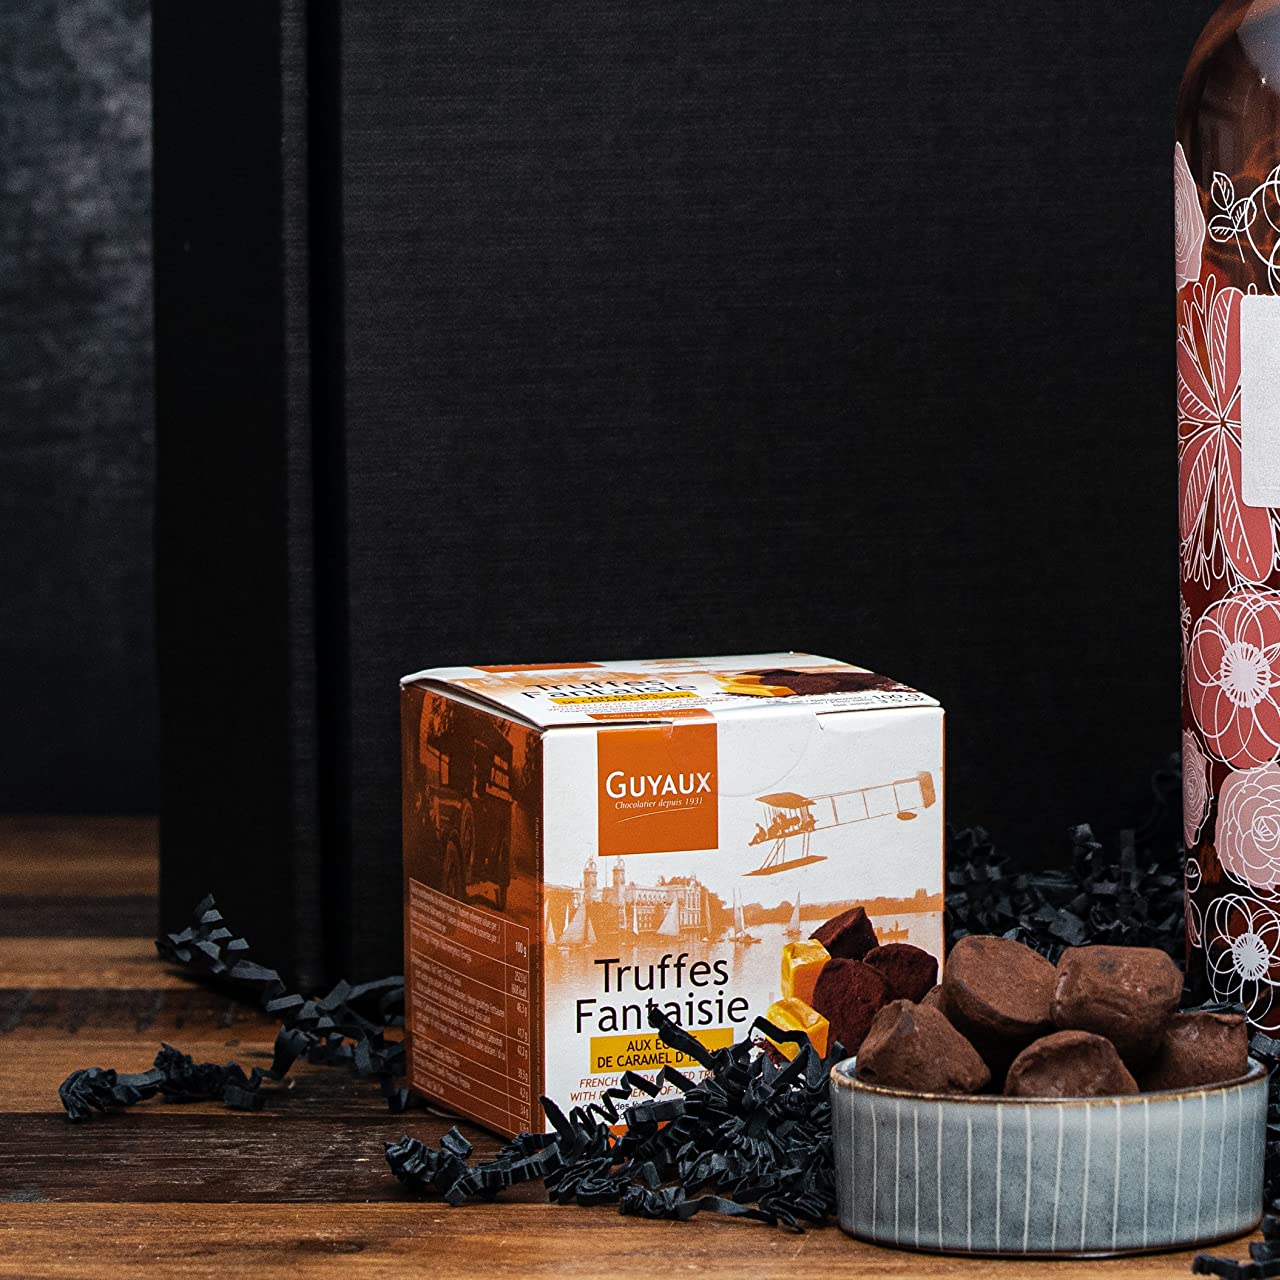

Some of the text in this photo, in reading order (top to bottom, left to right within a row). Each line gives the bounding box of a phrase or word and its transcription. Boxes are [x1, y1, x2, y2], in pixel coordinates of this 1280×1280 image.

[605, 770, 712, 799] GUYAUX
[615, 797, 703, 810] Chocolatier depuis 1931
[594, 952, 730, 993] Truffes
[576, 990, 750, 1034] Fantaisie
[626, 1039, 651, 1052] AUX
[597, 1056, 613, 1069] DE
[616, 1052, 673, 1067] CARAMEL
[579, 1075, 618, 1089] FRENCH
[570, 1091, 596, 1102] WITH
[660, 1085, 675, 1096] OF
[616, 1101, 630, 1111] des
